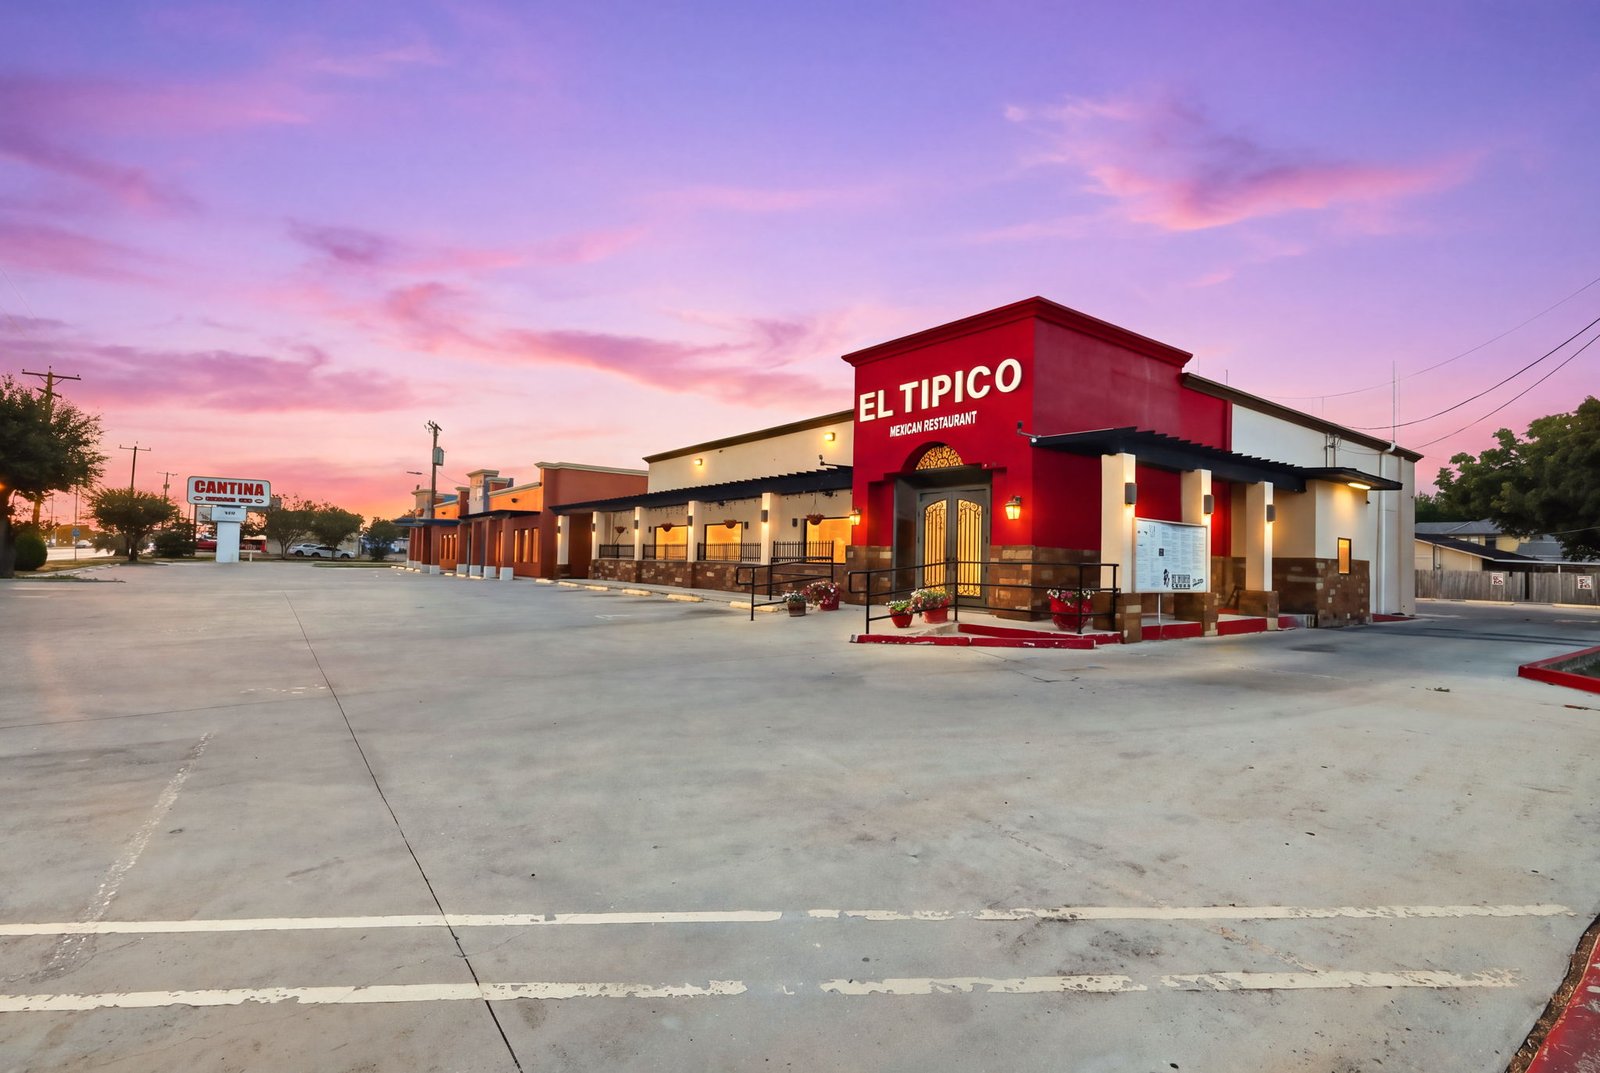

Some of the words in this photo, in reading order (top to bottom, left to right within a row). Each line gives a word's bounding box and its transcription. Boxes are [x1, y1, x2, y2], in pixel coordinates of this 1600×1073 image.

[859, 390, 893, 422] EL
[899, 358, 1022, 413] TIPICO
[889, 422, 922, 437] MEXICAN
[924, 411, 977, 431] RESTAURANT
[194, 480, 264, 496] CANTINA
